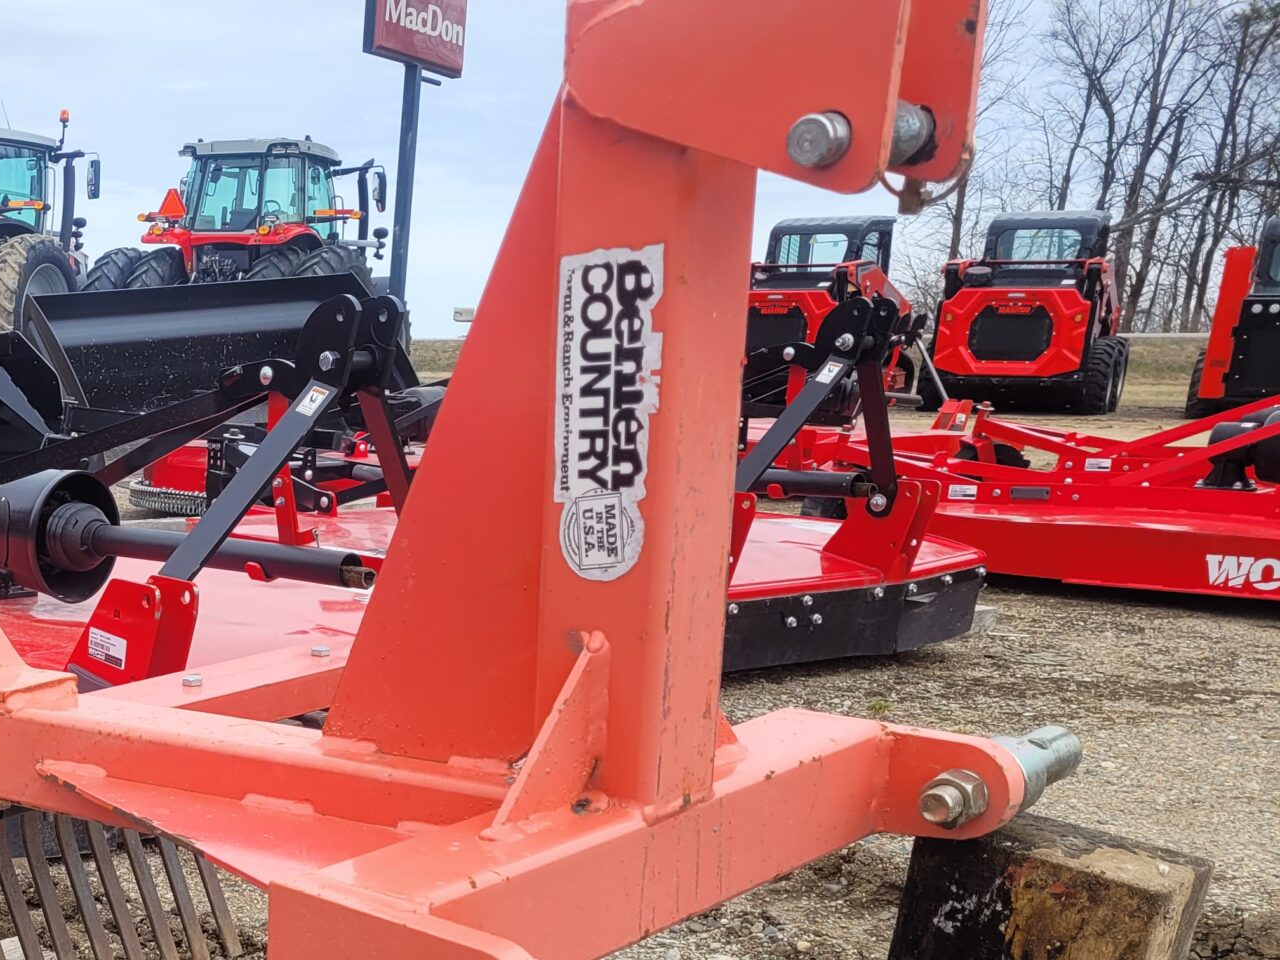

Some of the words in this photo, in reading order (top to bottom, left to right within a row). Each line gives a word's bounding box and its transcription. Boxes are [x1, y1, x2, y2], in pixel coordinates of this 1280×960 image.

[384, 0, 464, 47] MacDon
[562, 330, 575, 389] Ranch
[578, 260, 615, 492] COUNTRY
[582, 508, 596, 558] U.S.A.
[595, 511, 604, 524] IN
[596, 527, 606, 553] THE
[604, 503, 619, 558] MADE
[1206, 554, 1280, 591] WO
